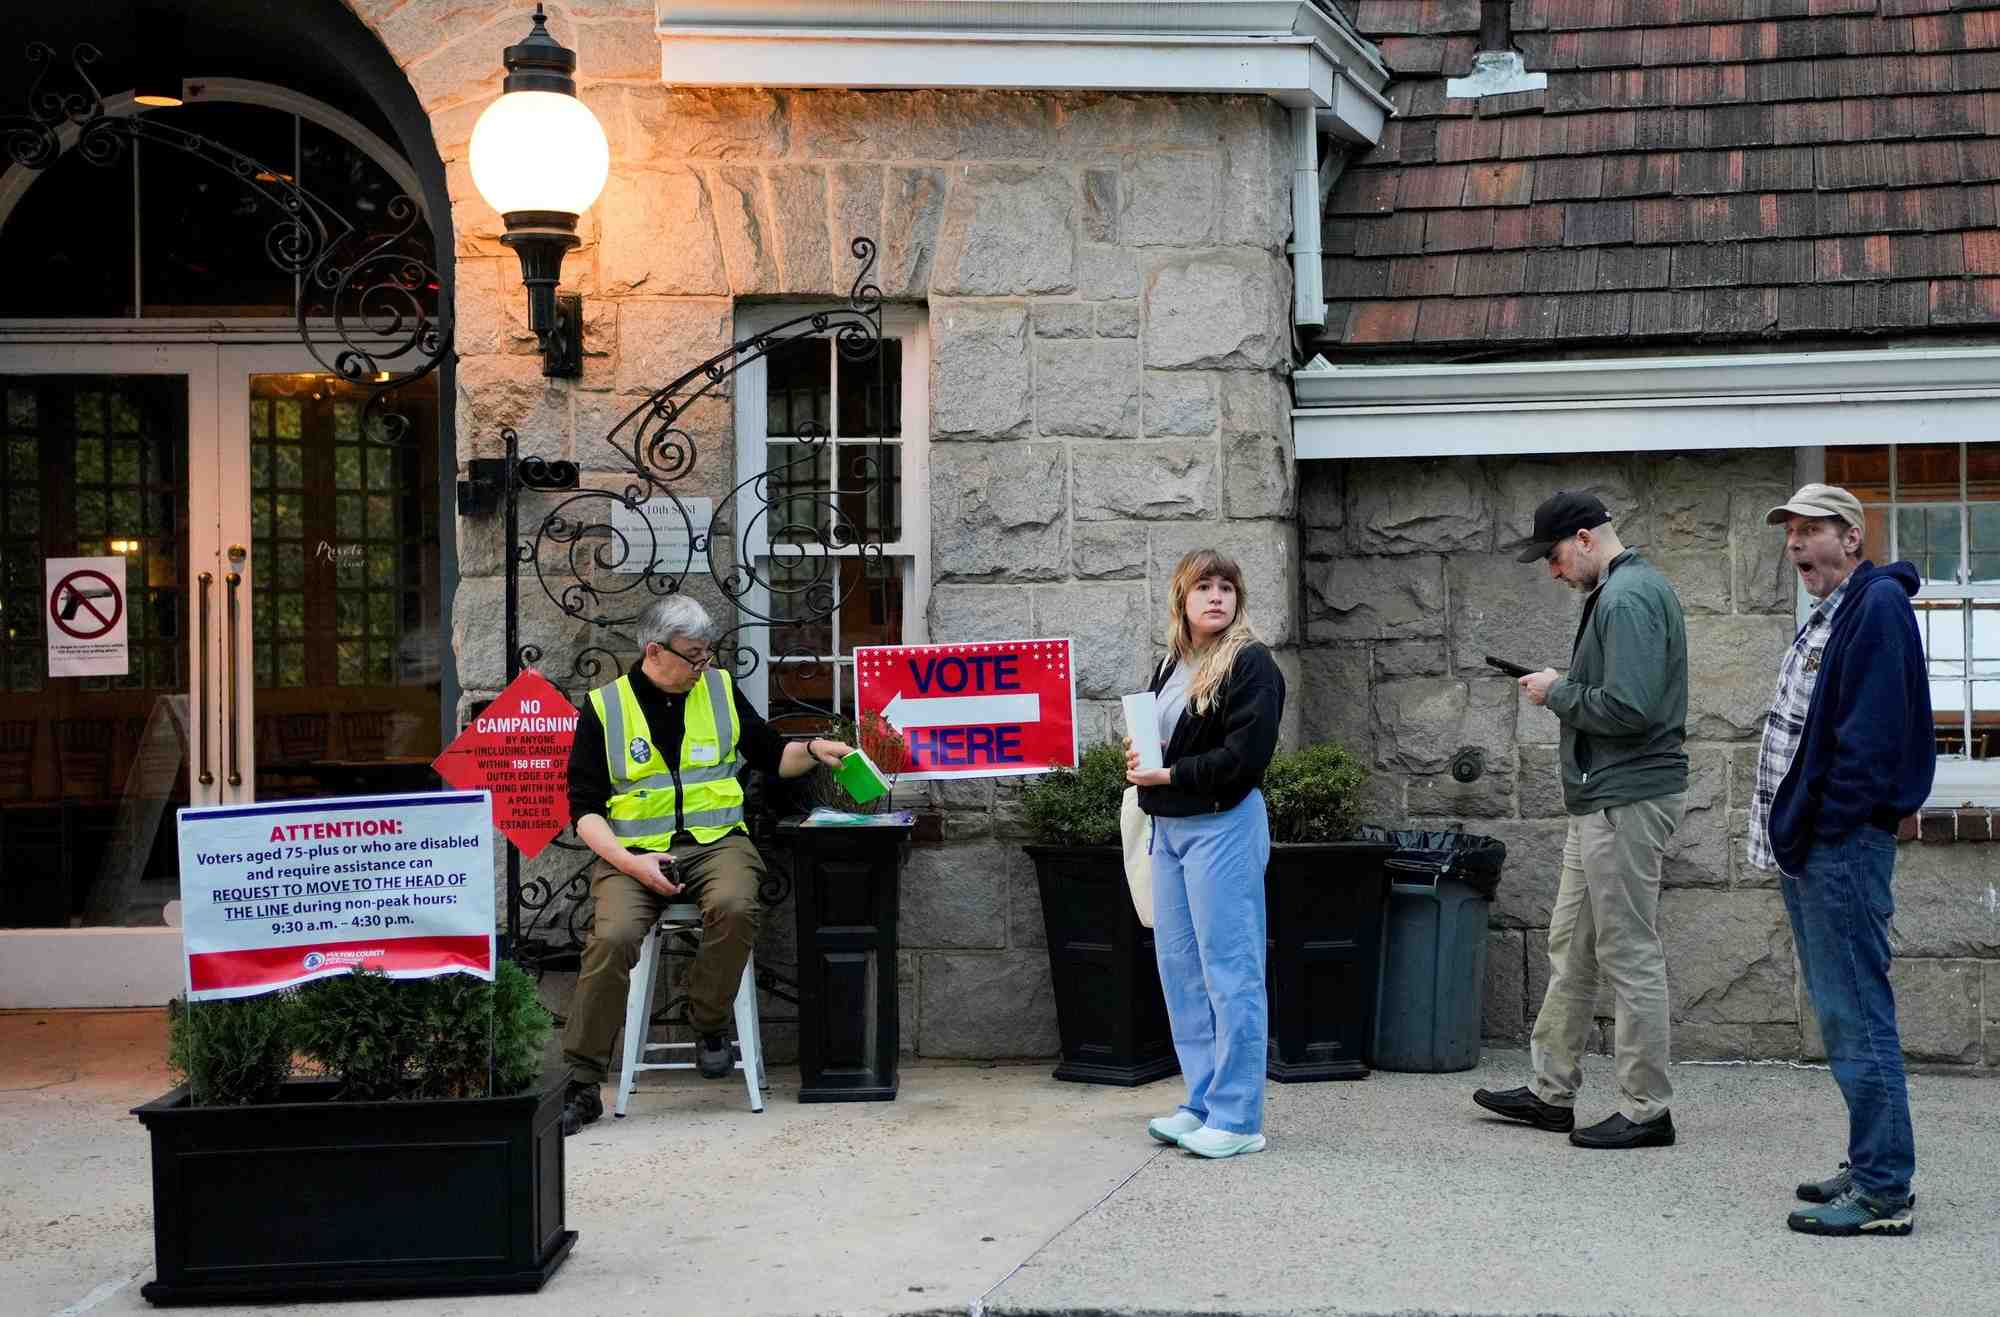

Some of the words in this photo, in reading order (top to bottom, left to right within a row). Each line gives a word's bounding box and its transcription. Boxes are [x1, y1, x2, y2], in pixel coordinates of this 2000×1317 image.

[908, 654, 1021, 694] VOTE
[520, 699, 541, 714] NO
[505, 735, 518, 745] BY
[520, 735, 556, 745] ANYONE
[910, 726, 1025, 767] HERE
[528, 745, 573, 756] CANDIDAT
[478, 759, 510, 770] WITHIN
[511, 759, 528, 769] 150
[530, 759, 551, 769] FEET
[552, 759, 565, 769] OF
[486, 771, 516, 781] OUTER
[518, 771, 542, 781] EDGE
[543, 771, 557, 781] OF
[557, 771, 568, 781] AN
[520, 783, 543, 793] WITH
[516, 796, 554, 805] POLLING
[511, 807, 539, 817] PLACE
[541, 807, 550, 817] IS
[270, 819, 403, 842] ATTENTION:
[197, 852, 243, 866] Voters
[246, 847, 281, 865] aged
[285, 844, 339, 860] 75-plus
[342, 844, 357, 855] or
[361, 840, 392, 854] who
[394, 840, 417, 852] are
[420, 835, 479, 850] disabled
[247, 866, 274, 881] and
[278, 863, 330, 880] require
[334, 859, 406, 873] assistance
[409, 858, 433, 869] can
[212, 884, 279, 903] REQUEST
[282, 883, 303, 897] TO
[306, 879, 350, 896] MOVE
[352, 878, 372, 891] TO
[375, 876, 401, 890] THE
[405, 873, 445, 888] HEAD
[448, 872, 467, 886] OF
[224, 905, 253, 920] THE
[257, 902, 290, 918] LINE
[293, 900, 342, 915] during
[345, 894, 410, 911] non-peak
[413, 893, 457, 906] hours:
[271, 920, 303, 935] 9:30
[306, 919, 338, 932] a.m.
[351, 915, 382, 928] 4:30
[384, 914, 415, 929] p.m.
